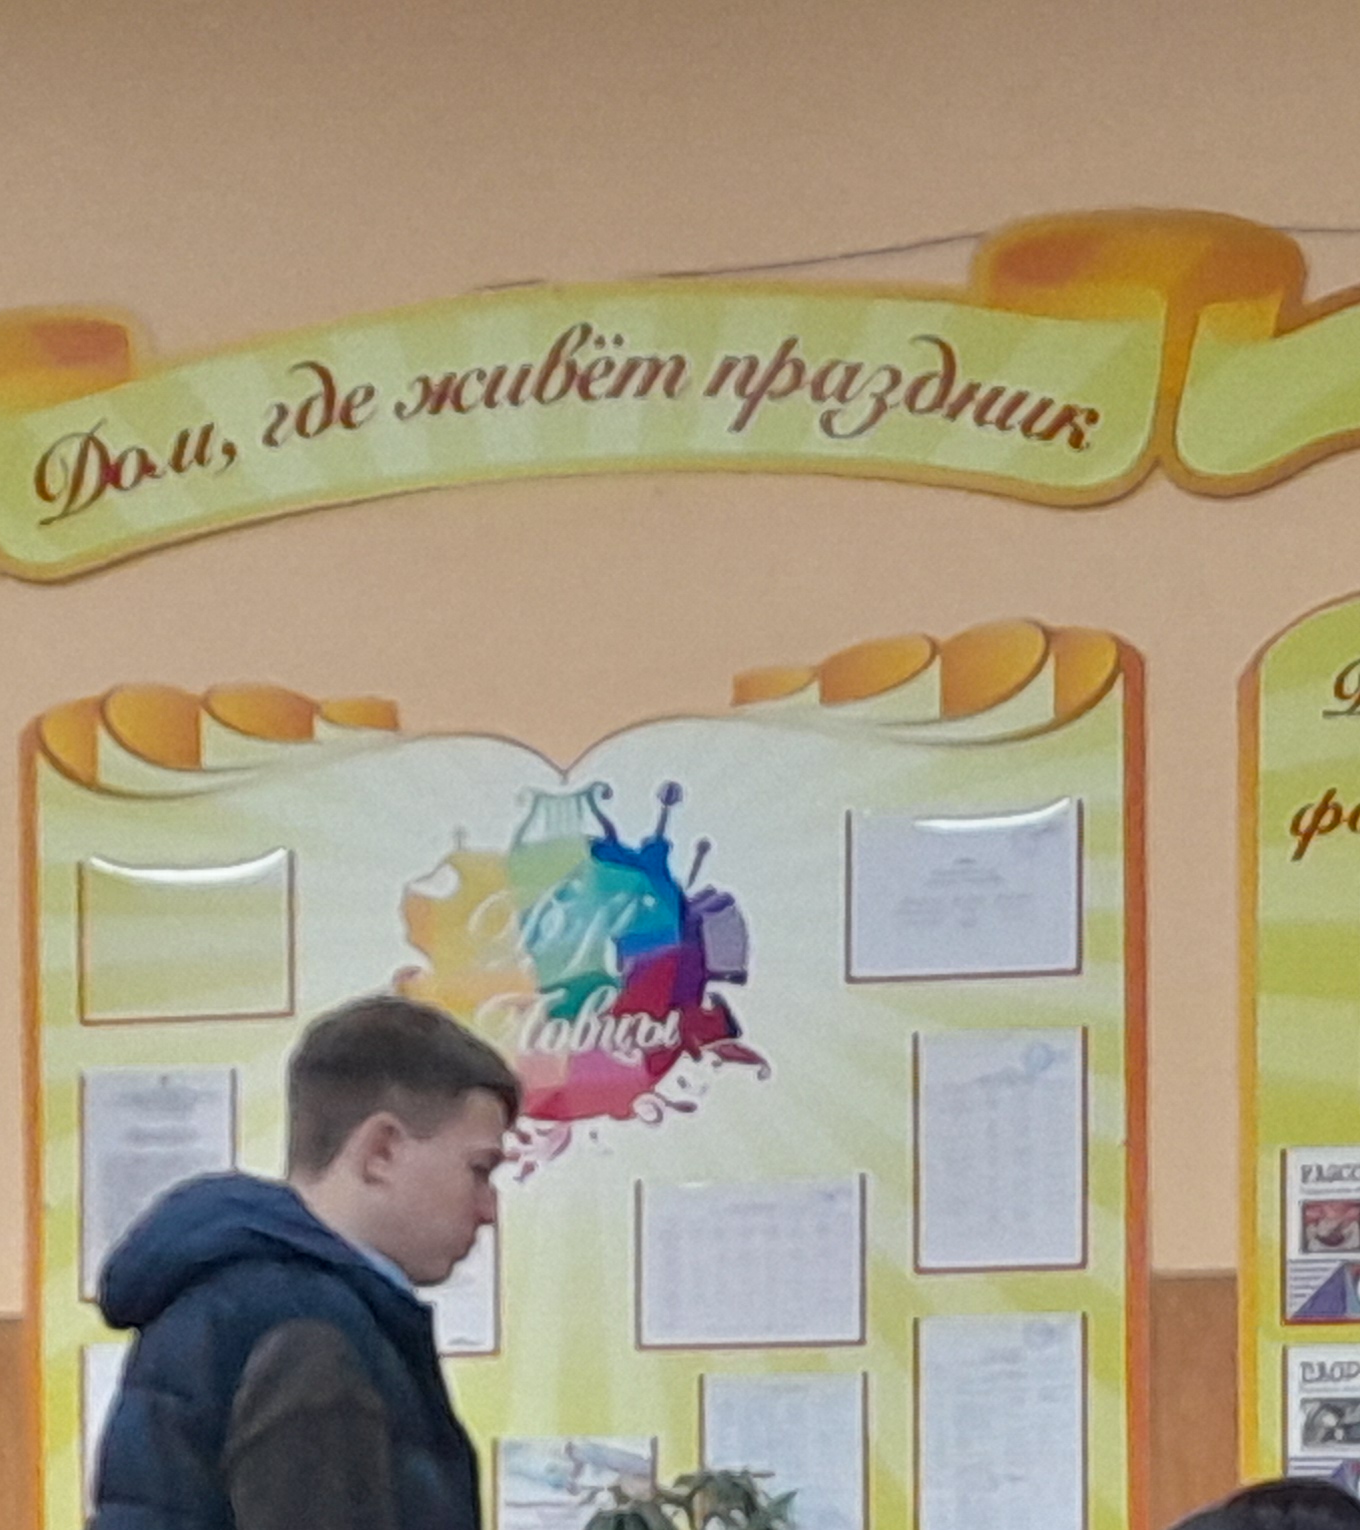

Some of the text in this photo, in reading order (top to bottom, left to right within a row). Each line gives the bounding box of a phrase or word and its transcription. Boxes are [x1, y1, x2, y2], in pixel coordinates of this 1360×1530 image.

[34, 321, 1100, 526] Дом, где живёт праздник
